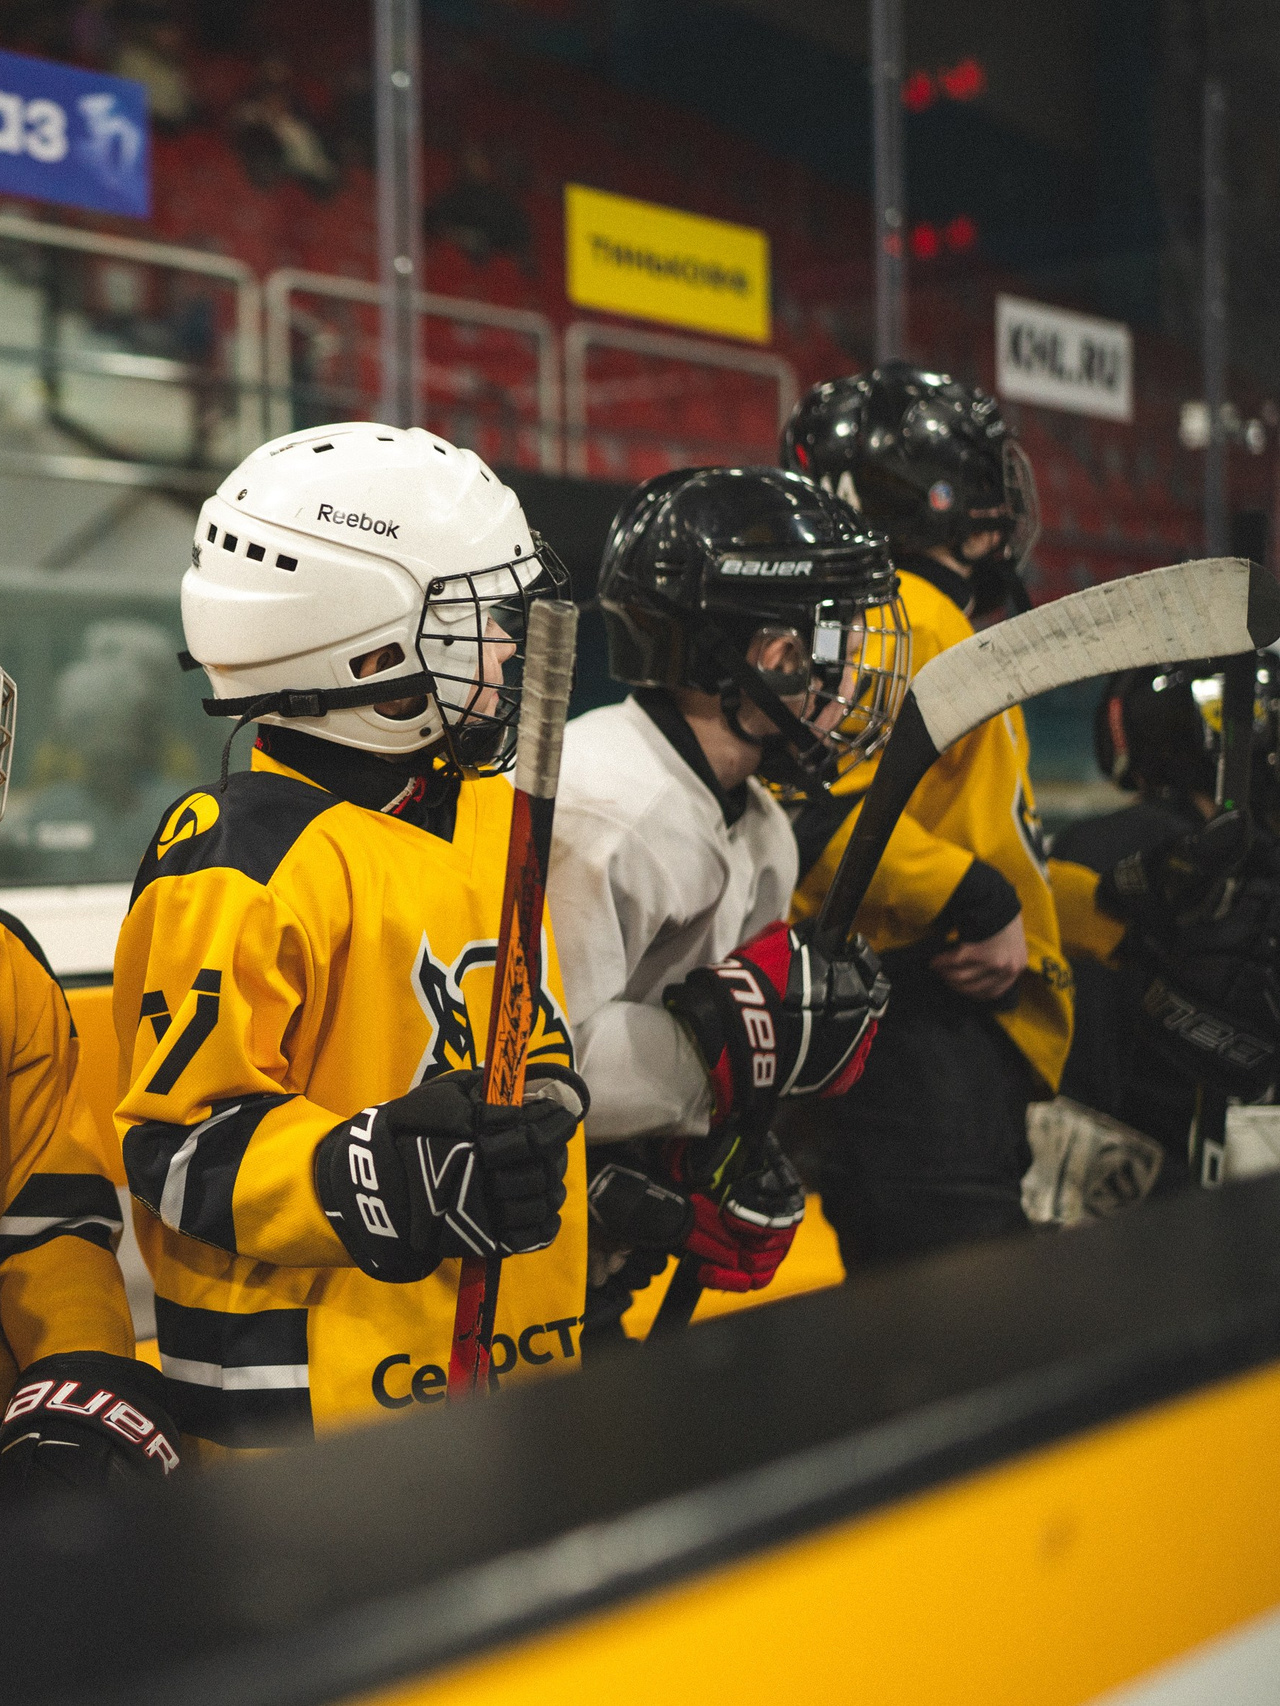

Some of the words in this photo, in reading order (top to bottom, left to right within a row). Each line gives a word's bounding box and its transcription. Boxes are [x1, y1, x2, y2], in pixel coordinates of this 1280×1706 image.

[317, 503, 400, 539] Reebok
[715, 959, 777, 1088] BAU
[348, 1104, 399, 1238] BAU
[2, 1380, 180, 1477] AUER
